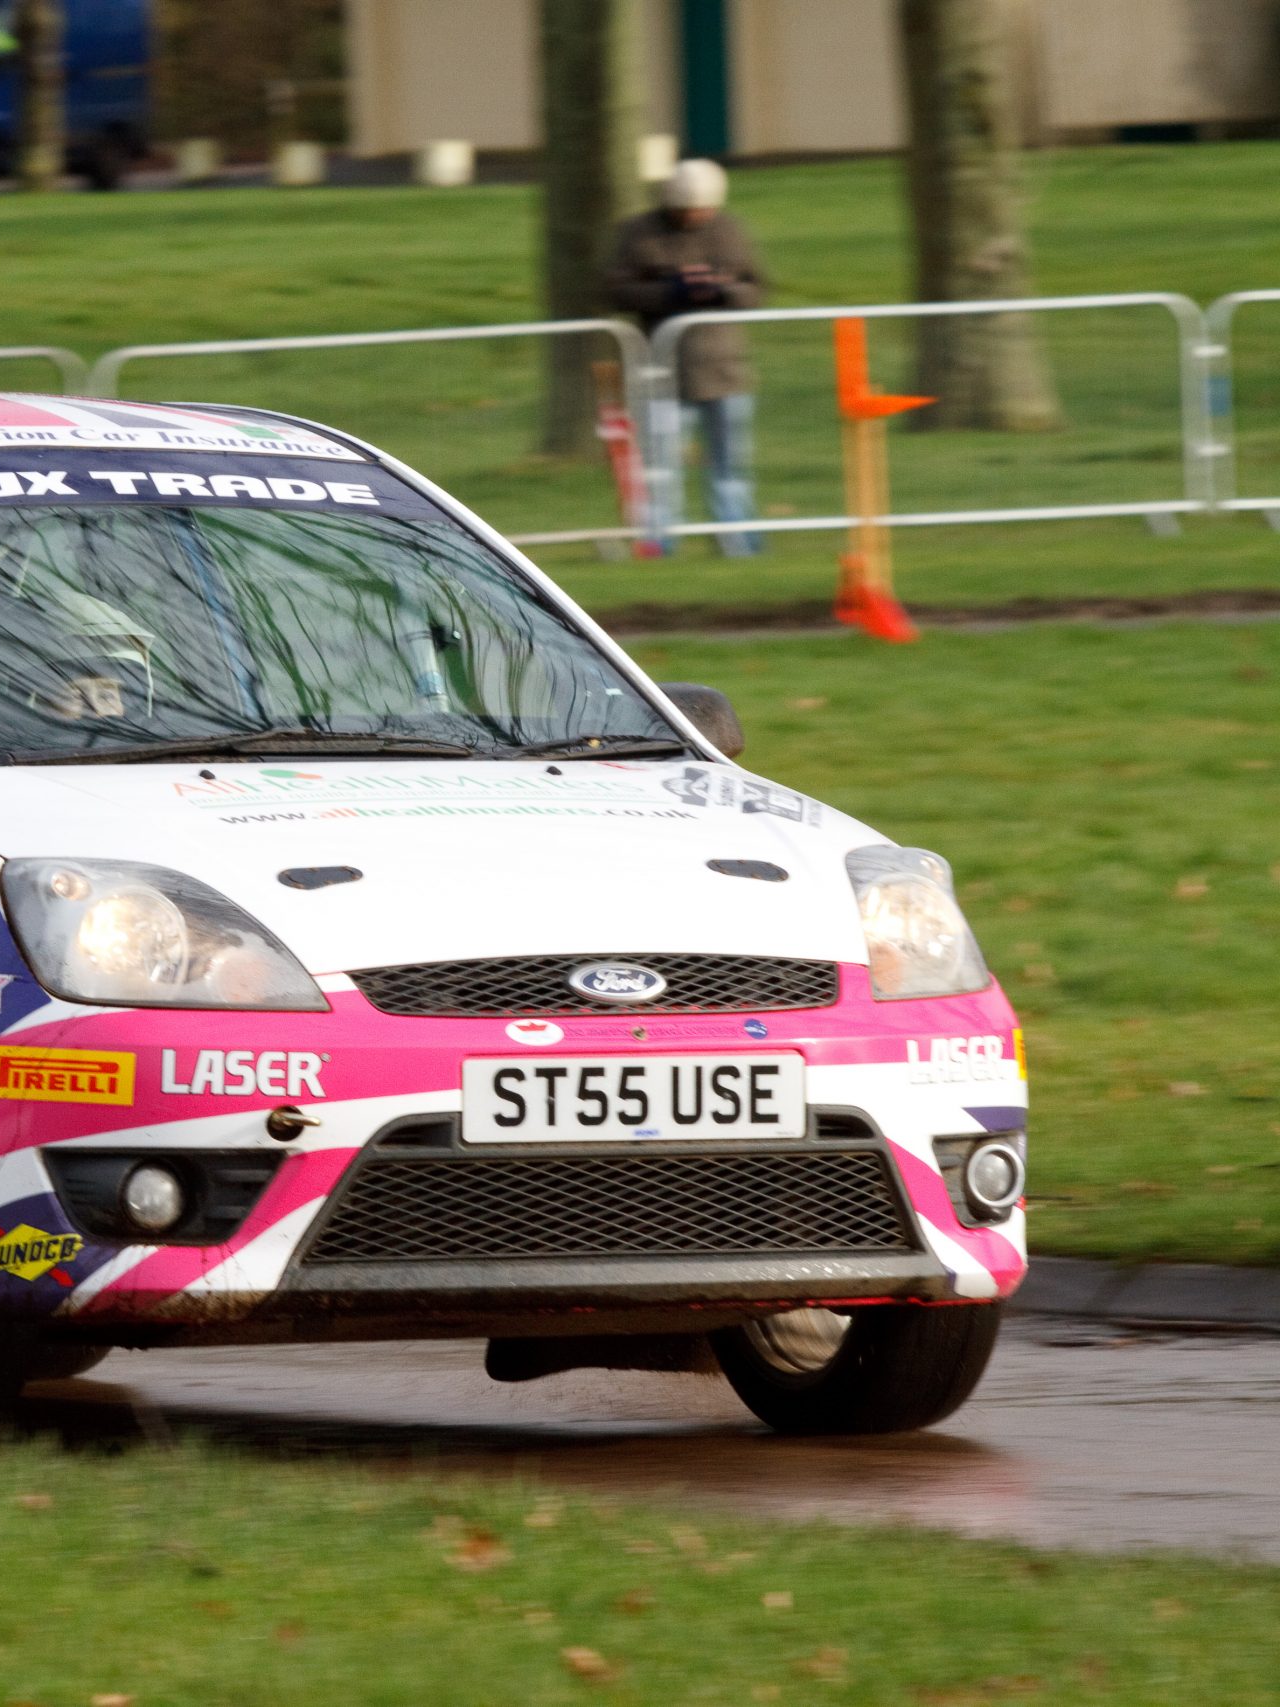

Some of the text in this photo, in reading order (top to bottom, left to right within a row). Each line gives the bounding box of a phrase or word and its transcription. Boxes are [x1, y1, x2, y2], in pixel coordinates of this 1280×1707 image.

[77, 427, 141, 442] Car
[158, 430, 343, 456] Insurance
[88, 470, 381, 506] TRADE
[218, 805, 699, 825] www.allhealthmatters.co.uk
[592, 968, 648, 992] Ford
[161, 1048, 327, 1098] LASER
[493, 1065, 780, 1127] ST55 USE
